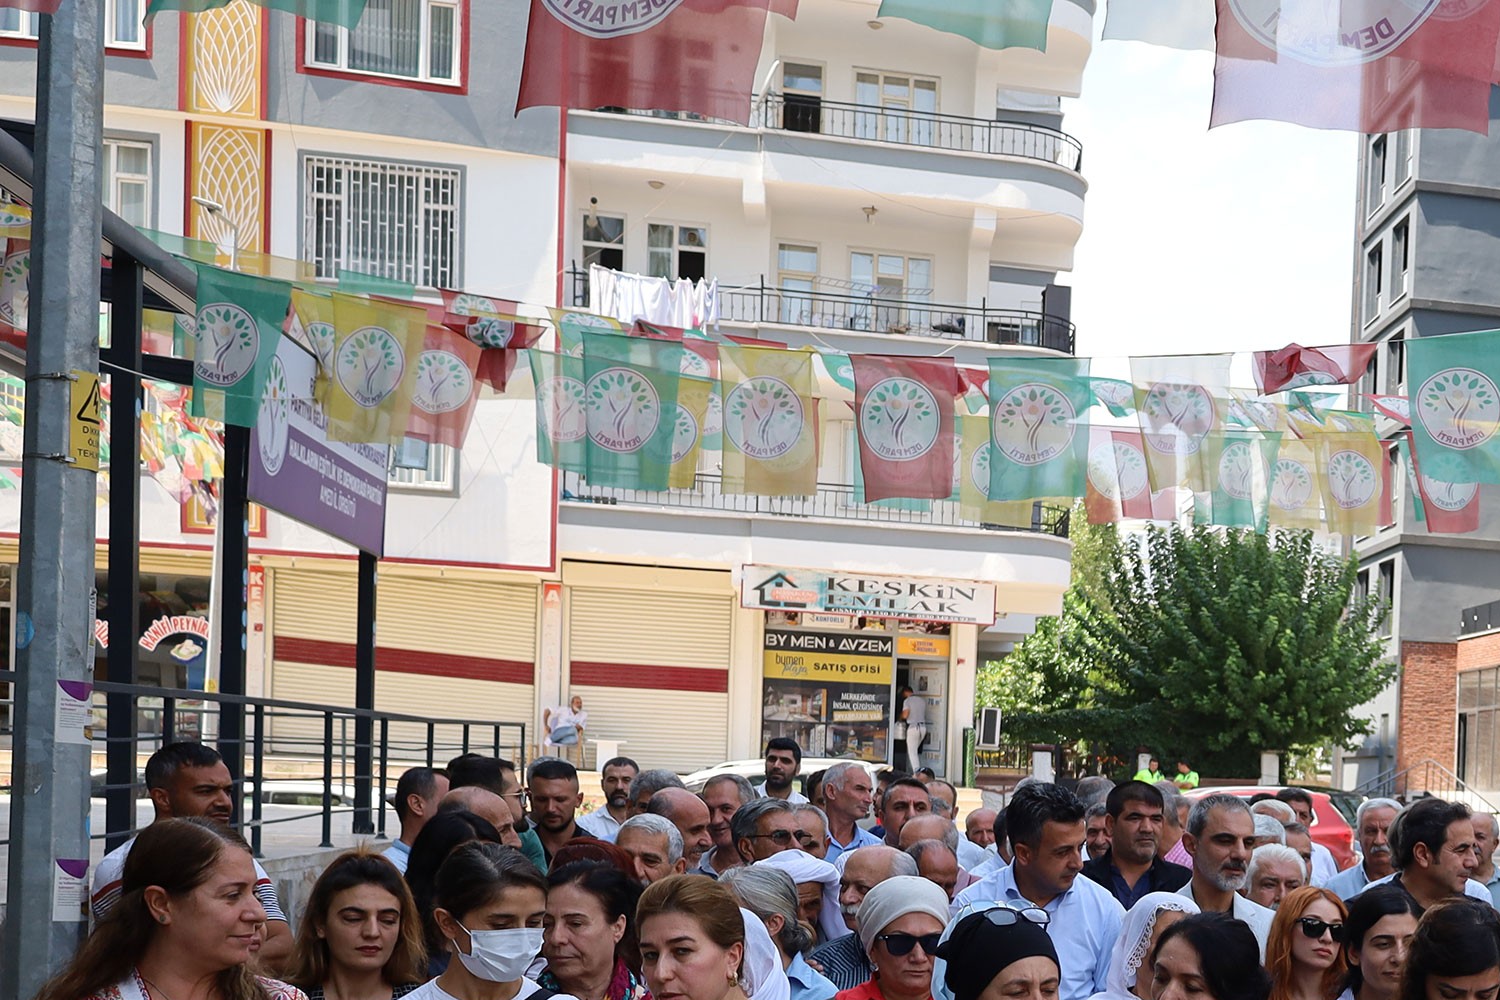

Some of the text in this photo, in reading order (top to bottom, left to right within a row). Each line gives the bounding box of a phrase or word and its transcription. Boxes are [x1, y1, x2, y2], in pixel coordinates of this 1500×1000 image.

[827, 594, 960, 614] EMLAK
[140, 616, 209, 650] HANİFİ PEYNİR
[766, 633, 787, 647] BY
[791, 635, 826, 649] MEN
[838, 638, 892, 653] AVZEM
[775, 653, 804, 668] bymen
[813, 662, 881, 674] SATIŞ OFİSİ
[841, 692, 876, 702] MERKEZİNDE
[852, 702, 883, 712] ÇİZGİSİNDE
